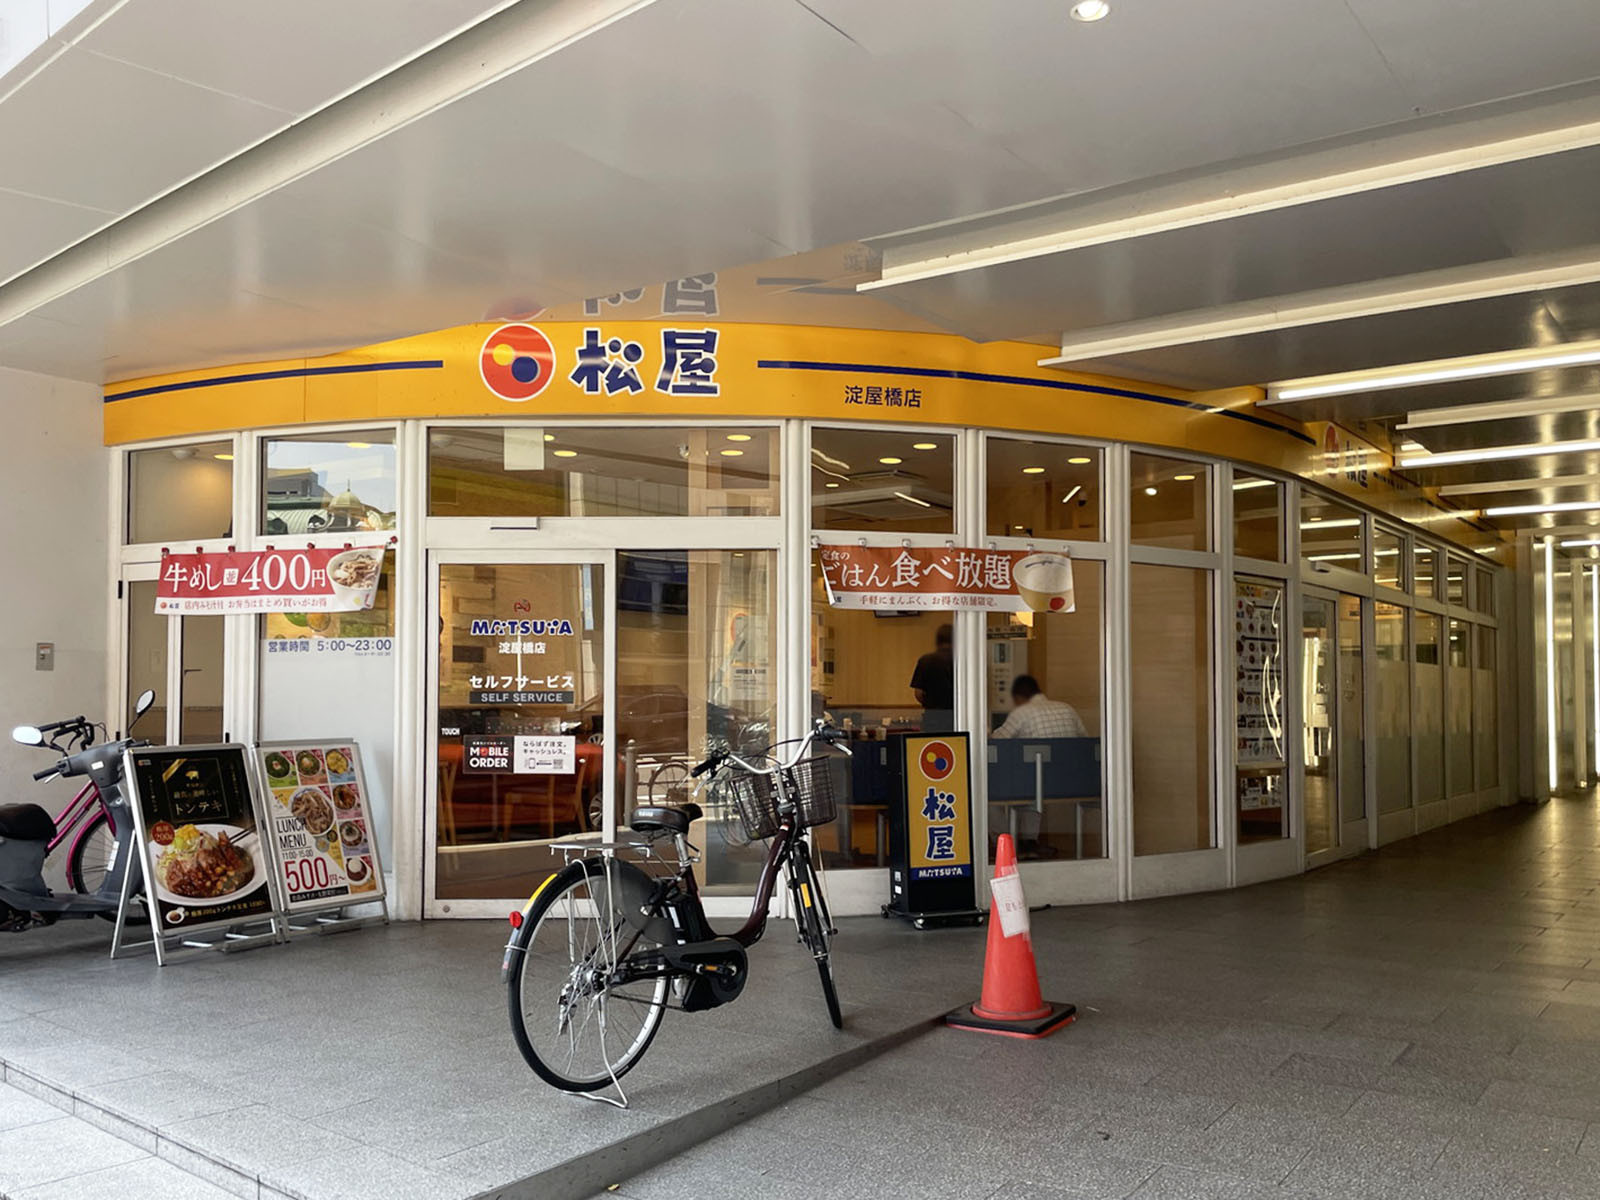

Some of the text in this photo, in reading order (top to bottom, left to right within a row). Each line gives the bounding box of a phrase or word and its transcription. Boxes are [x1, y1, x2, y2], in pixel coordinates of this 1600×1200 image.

[570, 328, 721, 397] 松屋
[844, 384, 922, 408] 淀屋橋店
[470, 619, 574, 636] MATSUYA
[268, 641, 310, 653] 営業時間
[499, 642, 547, 654] 淀屋橋店
[470, 675, 575, 689] セルフサービス
[481, 692, 563, 702] SELF SERVICE
[469, 747, 509, 757] MOBILE
[469, 757, 509, 768] ORDER
[276, 817, 305, 833] LUNCH
[921, 787, 957, 860] 松屋
[279, 834, 307, 849] MENU
[918, 867, 963, 878] MATSUYA
